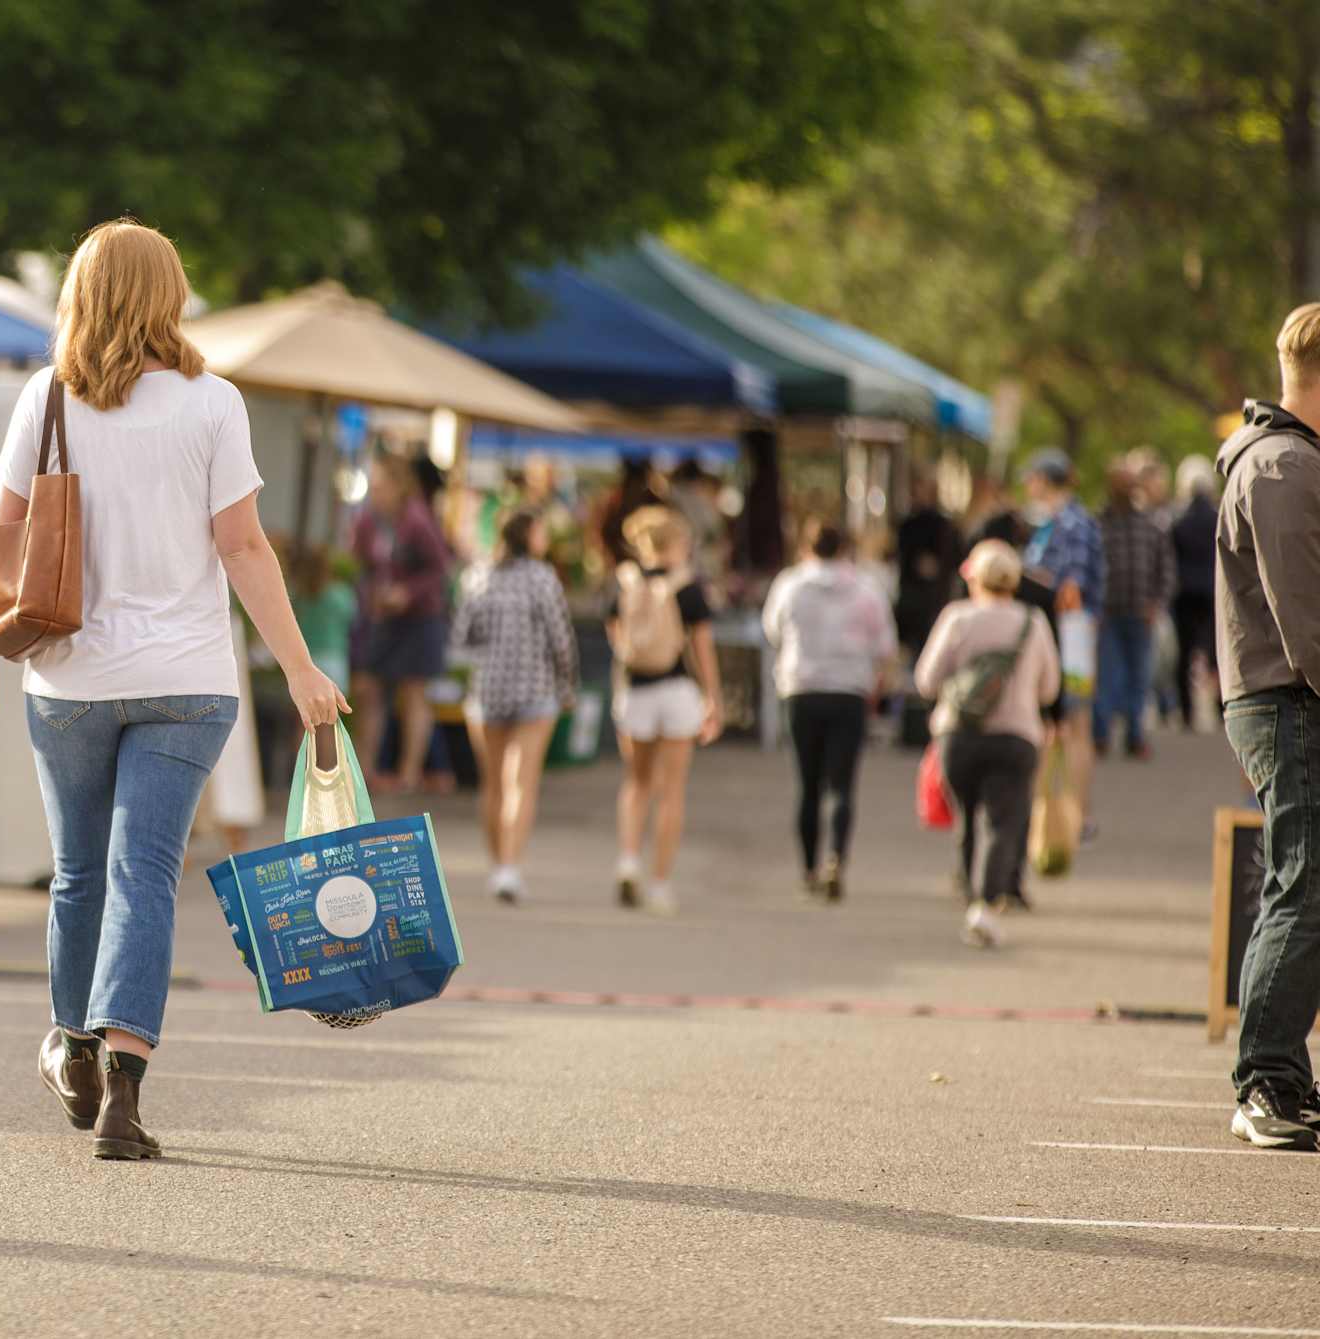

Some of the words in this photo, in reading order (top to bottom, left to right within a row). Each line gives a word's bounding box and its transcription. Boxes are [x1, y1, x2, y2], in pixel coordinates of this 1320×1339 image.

[267, 860, 286, 872] HIP
[326, 853, 356, 867] PARK
[257, 870, 288, 886] STRIP
[405, 876, 421, 884] SHOP
[407, 884, 424, 892] DINE
[283, 967, 312, 985] XXXX
